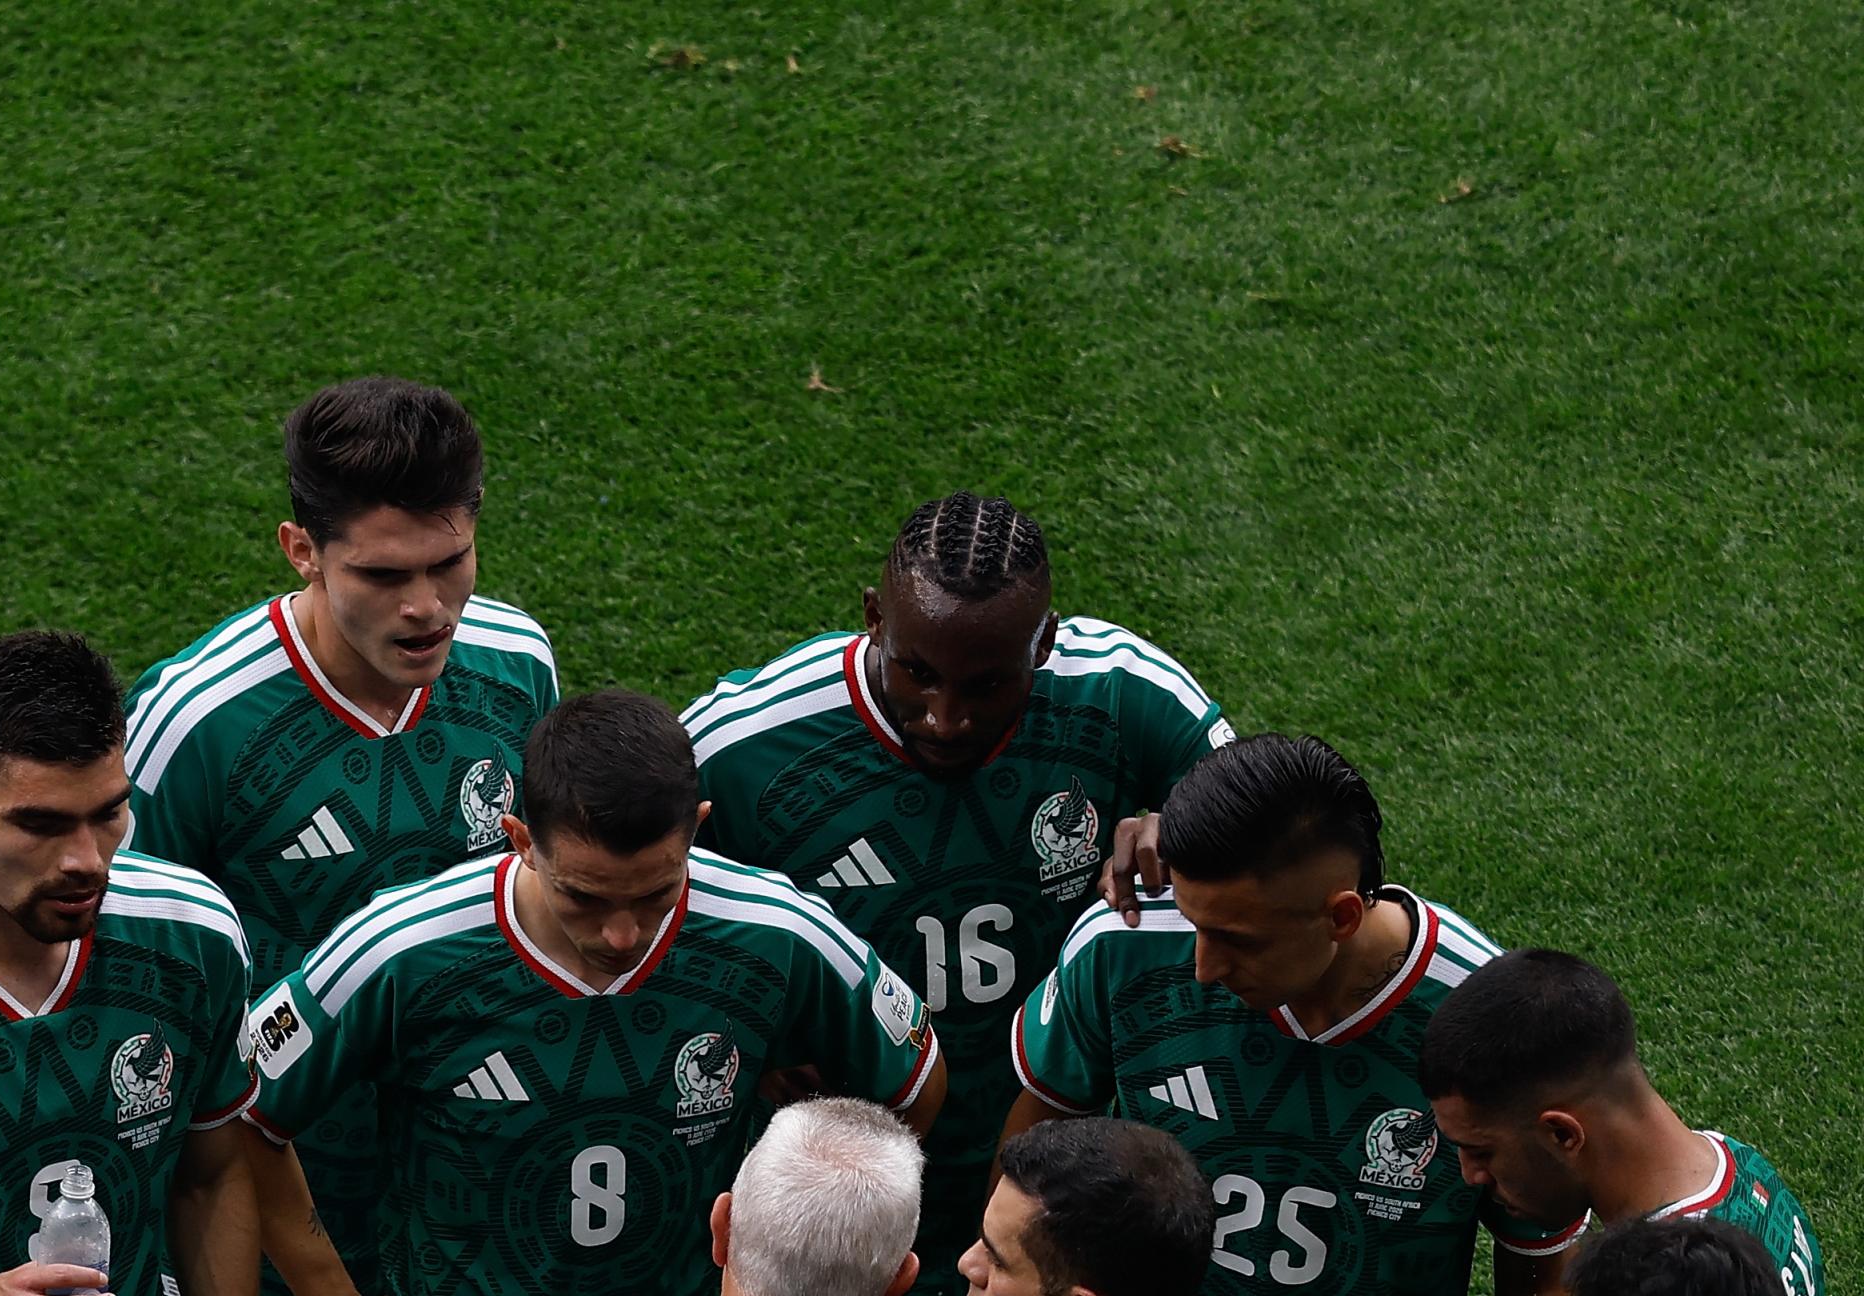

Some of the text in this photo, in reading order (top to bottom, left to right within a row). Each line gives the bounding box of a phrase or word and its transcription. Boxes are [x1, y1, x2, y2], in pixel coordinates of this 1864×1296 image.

[468, 827, 507, 848] MÉXIC
[1041, 851, 1098, 880] MÉXICO
[916, 903, 1016, 1012] 16
[119, 1095, 170, 1121] MÉXICO
[679, 1096, 732, 1116] MÉXICO
[1361, 1169, 1422, 1188] MÉXICO
[570, 1145, 626, 1247] 8
[1212, 1173, 1337, 1287] 25
